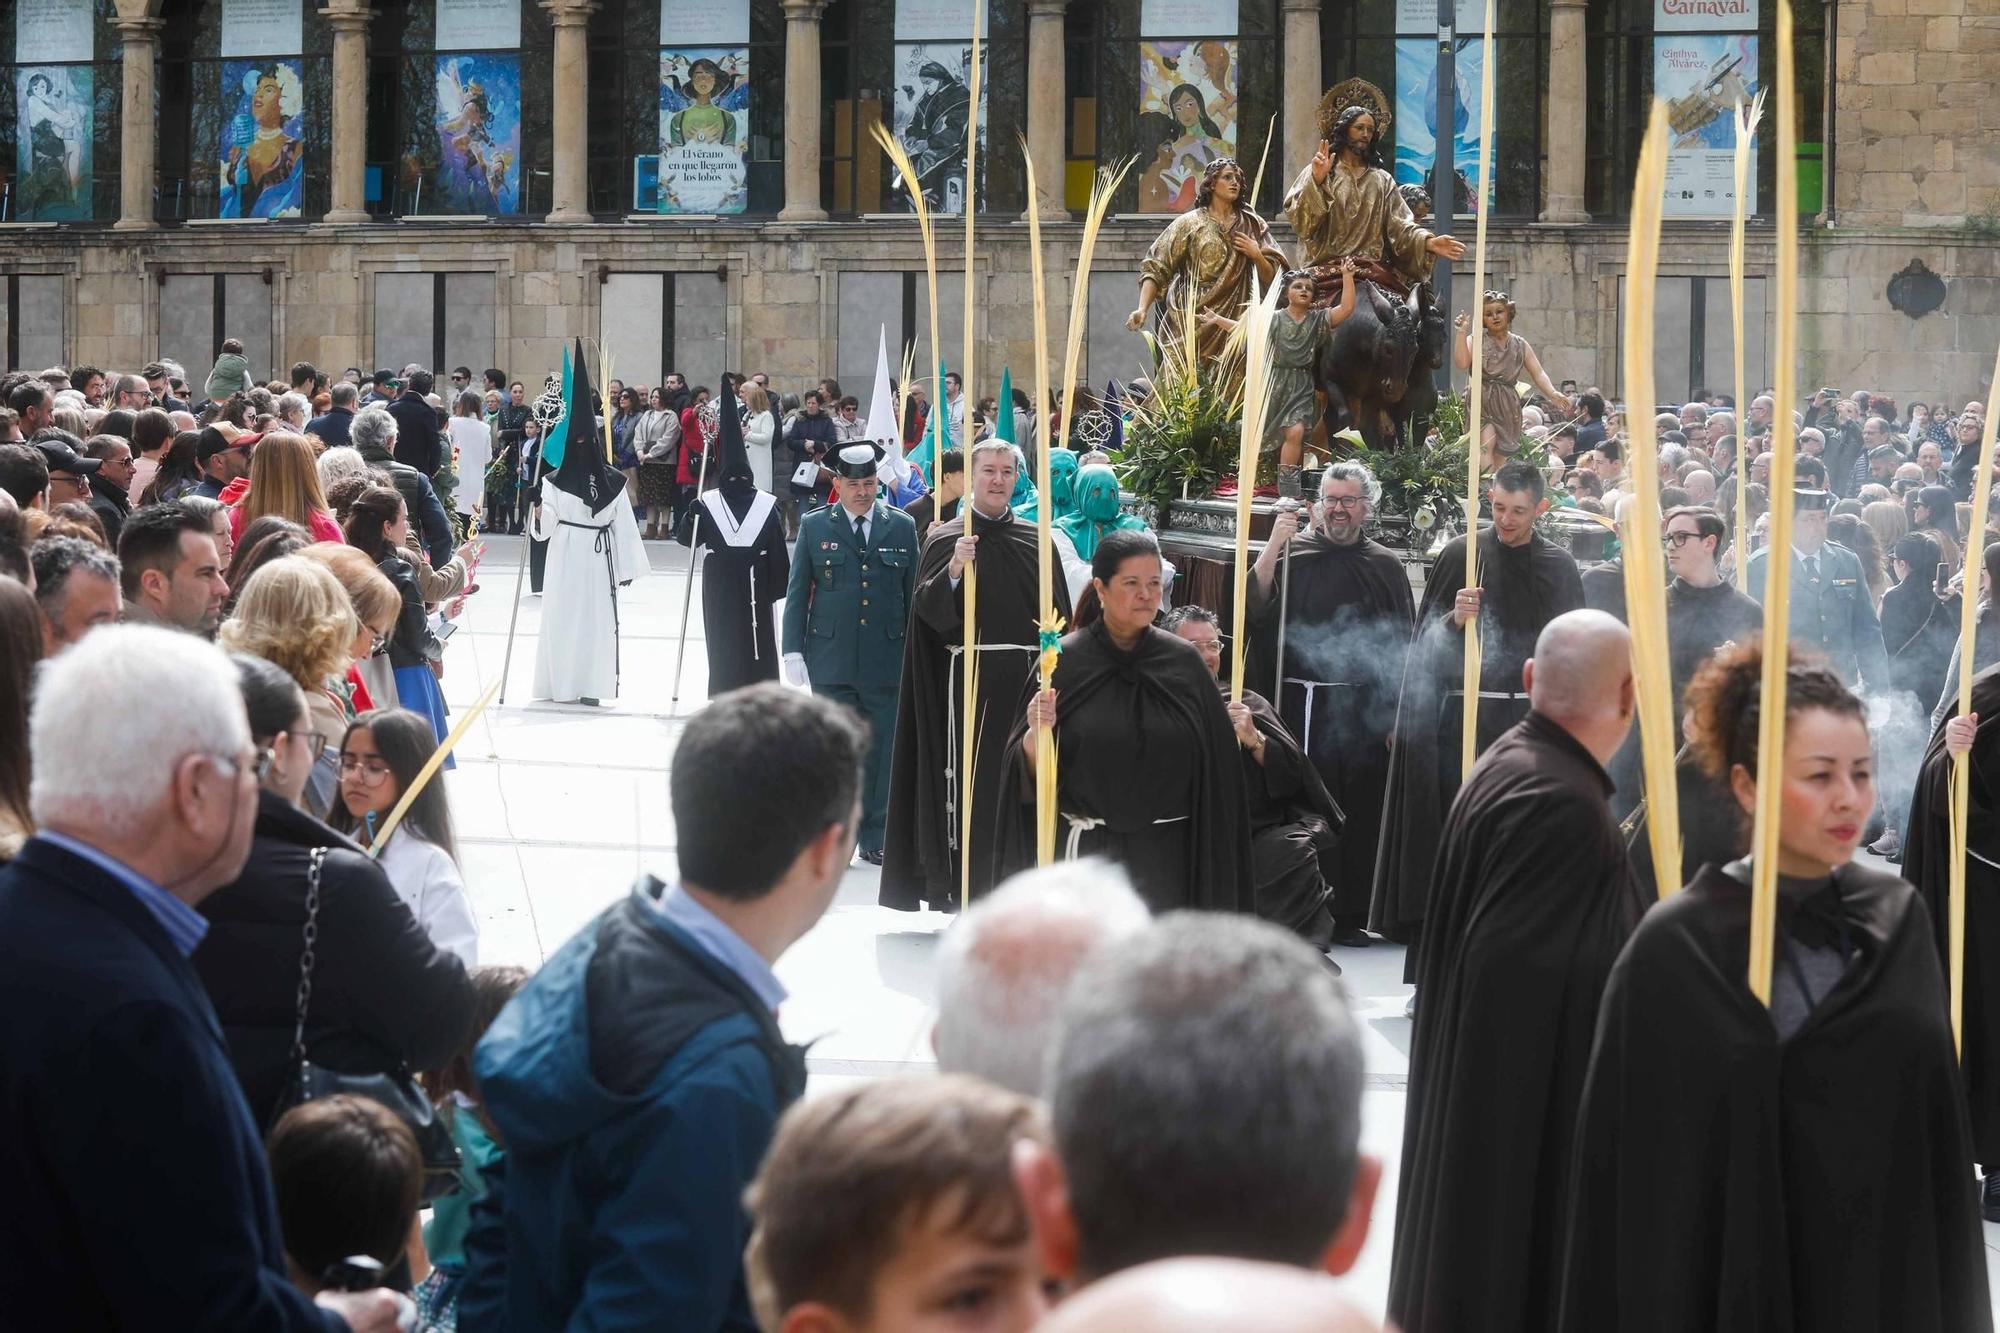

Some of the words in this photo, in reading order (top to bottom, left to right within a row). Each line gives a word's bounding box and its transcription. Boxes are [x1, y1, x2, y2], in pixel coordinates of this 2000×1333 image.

[1663, 0, 1750, 17] Carnaval.
[682, 149, 691, 159] El
[692, 150, 724, 159] verano
[682, 163, 699, 172] que
[700, 161, 737, 174] llegaron
[683, 172, 696, 181] los
[698, 172, 722, 181] lobos
